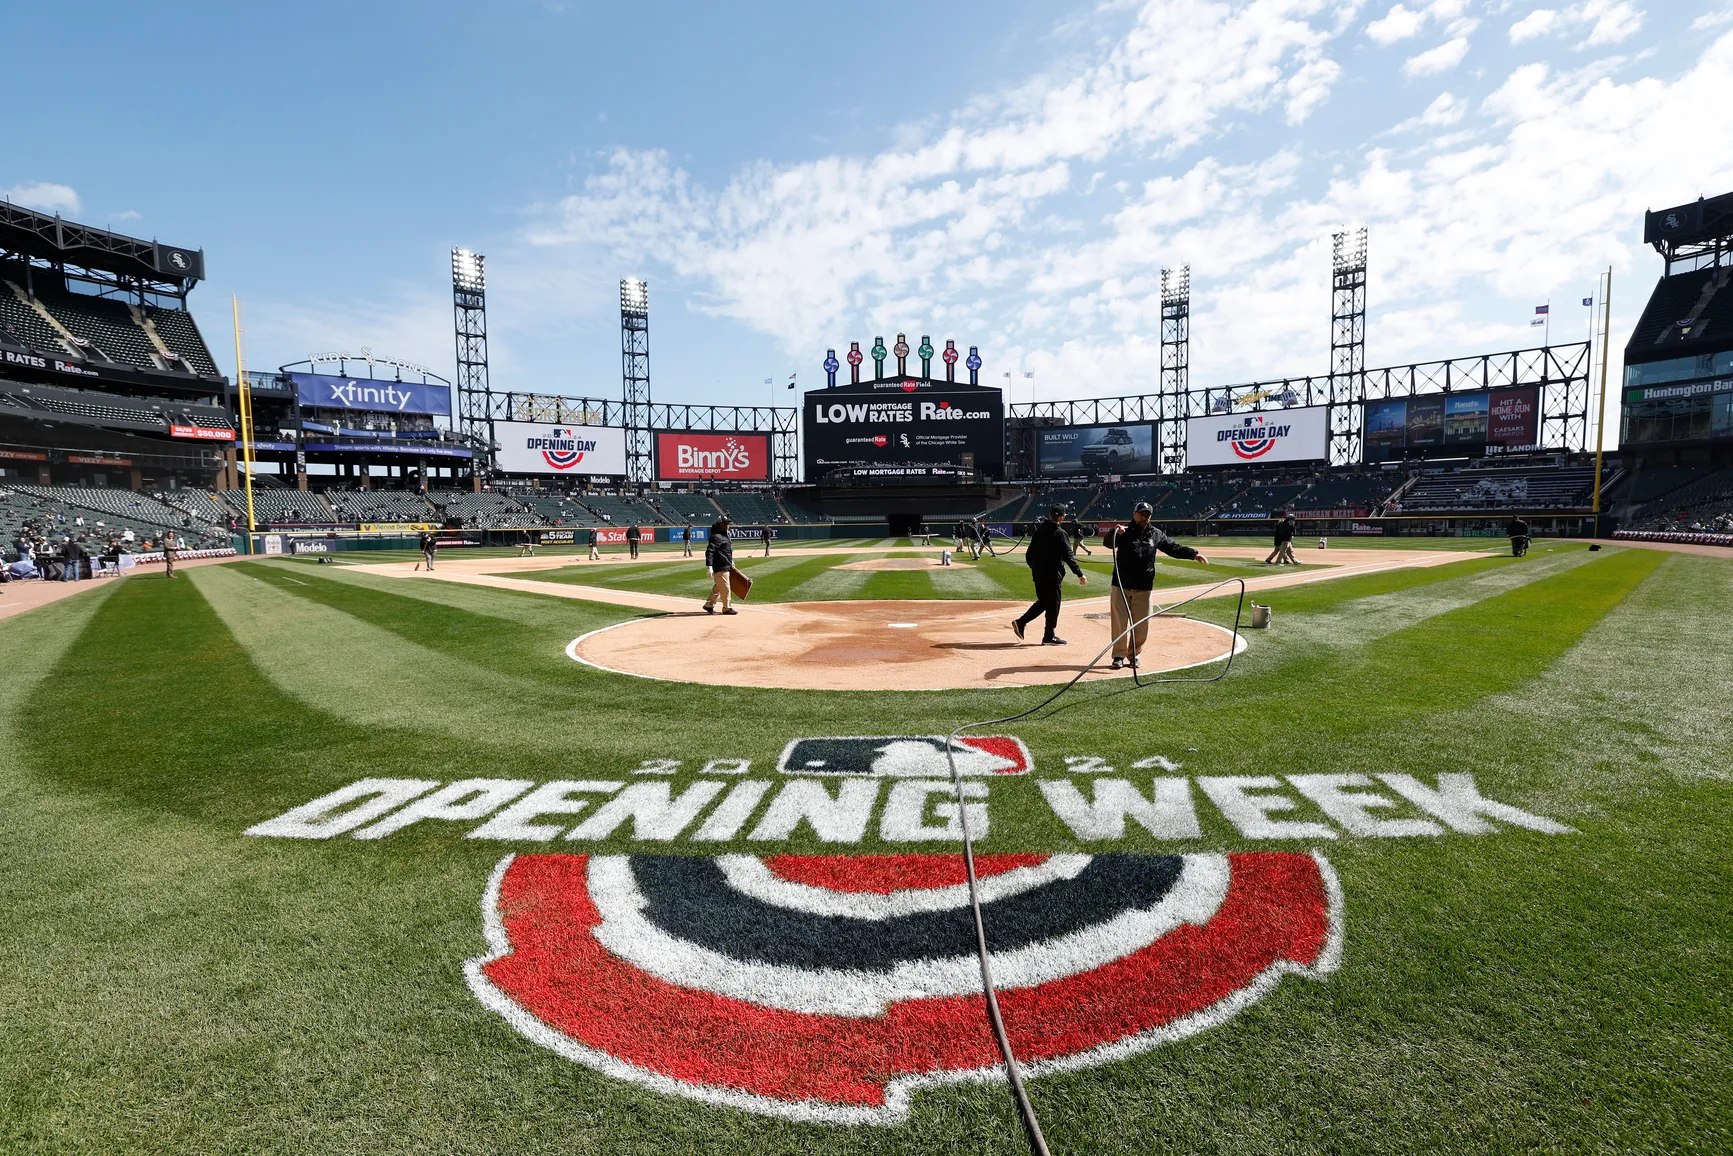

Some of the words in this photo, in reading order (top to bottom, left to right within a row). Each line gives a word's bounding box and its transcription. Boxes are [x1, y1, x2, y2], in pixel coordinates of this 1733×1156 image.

[6, 351, 46, 368] RATES
[55, 361, 99, 376] Rate.com
[309, 352, 352, 365] KIDS
[384, 356, 429, 376] ZONE
[873, 381, 904, 389] guaranteed
[330, 381, 412, 410] xfinity
[1644, 383, 1711, 400] Huntington
[816, 404, 868, 423] LOW
[920, 402, 990, 420] Rate.com
[1492, 406, 1513, 416] HOME
[1514, 404, 1531, 413] RUN
[869, 411, 913, 423] RATES
[197, 430, 231, 438] $50,000
[1217, 426, 1266, 442] OPENING
[1268, 425, 1291, 438] DAY
[527, 438, 575, 450] OPENING
[577, 441, 597, 452] DAY
[1506, 444, 1547, 453] LANDING
[590, 476, 611, 484] Modelo
[1333, 509, 1355, 517] MEATS
[1352, 523, 1383, 531] Rate.com
[549, 531, 556, 540] 5
[608, 532, 626, 542] Stat
[296, 542, 327, 553] Modelo
[632, 758, 751, 775] 20
[1063, 755, 1183, 773] 24
[243, 778, 989, 841] OPENING
[1035, 772, 1582, 840] WEEK
